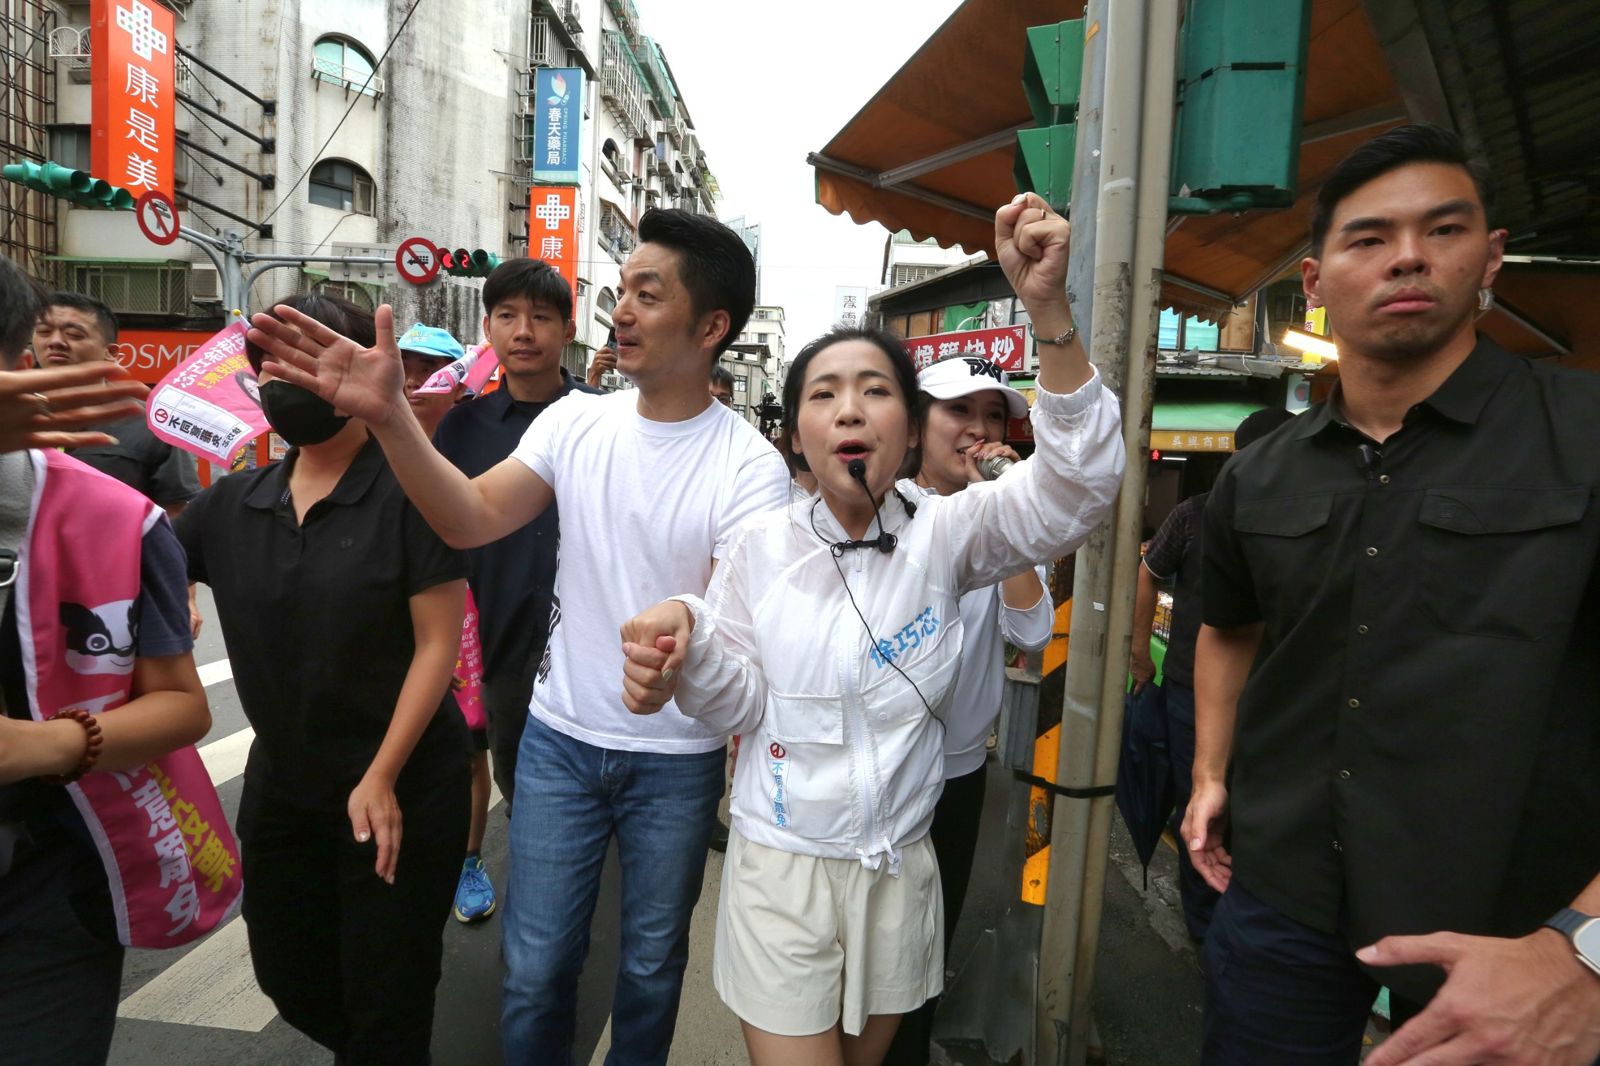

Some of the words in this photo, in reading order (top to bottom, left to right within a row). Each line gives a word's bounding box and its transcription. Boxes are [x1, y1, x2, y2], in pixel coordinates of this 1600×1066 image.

[125, 62, 160, 191] 康是美
[546, 107, 562, 166] 春天藥局
[540, 235, 563, 274] 康
[869, 606, 941, 669] 徐巧芯
